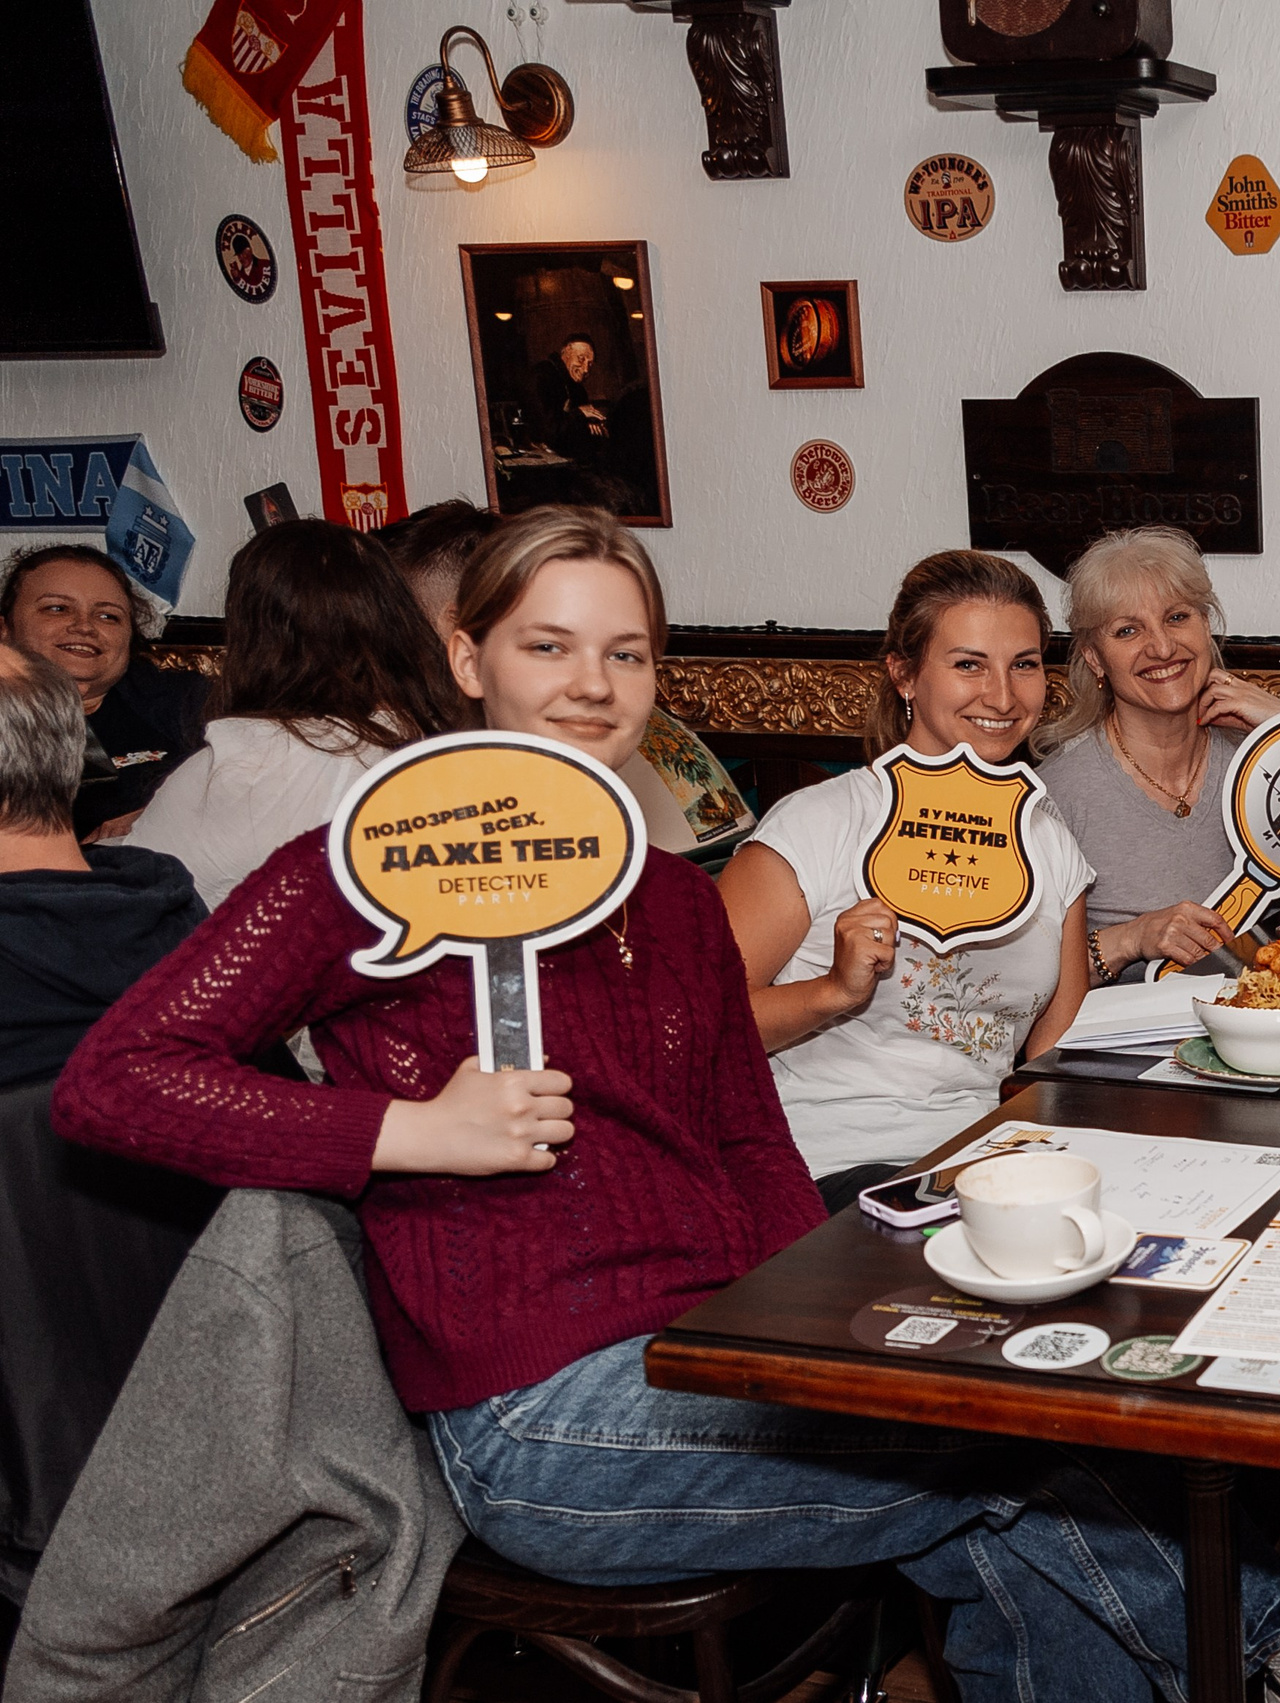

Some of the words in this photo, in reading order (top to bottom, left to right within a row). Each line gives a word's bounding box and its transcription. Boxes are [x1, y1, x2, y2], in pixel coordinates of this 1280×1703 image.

[926, 188, 973, 198] TRADITIONAL
[1226, 175, 1267, 196] John
[1217, 191, 1278, 213] Smith's
[1224, 211, 1272, 230] Bitter
[294, 75, 385, 448] SEVILLA
[237, 265, 271, 296] BITTER
[248, 385, 273, 399] BITTER
[0, 451, 119, 517] INA
[802, 487, 839, 507] Biere
[981, 483, 1090, 524] Beer
[1097, 483, 1242, 525] House
[362, 796, 518, 841] ПОДОЗРЕВАЮ
[918, 807, 930, 819] Я
[932, 809, 944, 820] У
[944, 811, 993, 828] МАМЫ
[897, 820, 1008, 849] ДЕТЕКТИВ
[381, 840, 503, 873] ДАЖЕ
[510, 835, 601, 863] ТЕБЯ
[438, 872, 549, 895] DETECTIVE
[908, 868, 991, 891] DETECTIVE
[459, 891, 533, 906] PARTY
[920, 884, 976, 900] PARTY
